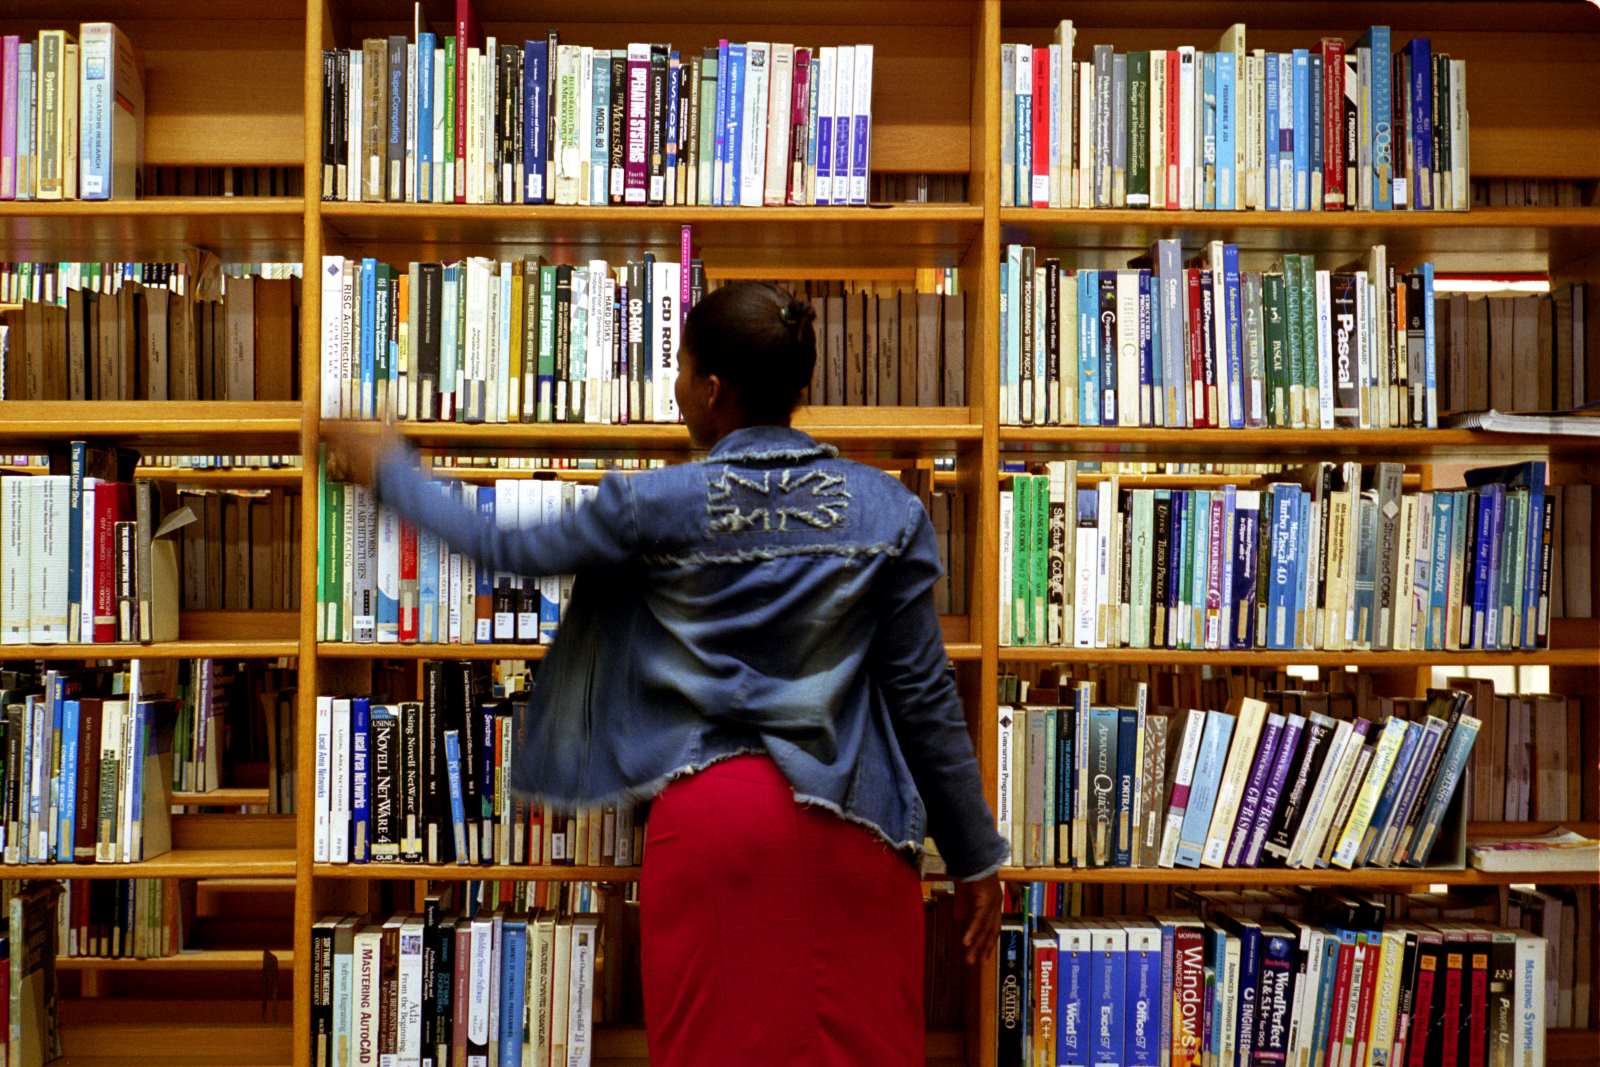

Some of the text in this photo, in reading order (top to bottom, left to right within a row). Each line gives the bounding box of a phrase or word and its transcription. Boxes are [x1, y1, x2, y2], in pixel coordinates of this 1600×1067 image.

[45, 71, 55, 109] Systems
[391, 70, 401, 143] SuperComputing
[654, 77, 662, 116] COMPUTER
[596, 108, 605, 147] MODEL 80
[613, 105, 623, 143] MODELS
[629, 68, 647, 163] OPERATING SYSTEMS
[1204, 136, 1215, 162] LISP
[629, 299, 642, 343] CD-ROM
[1289, 286, 1298, 325] DIGITAL
[1304, 287, 1314, 326] DIGITAL
[342, 314, 352, 378] Architecture
[662, 296, 671, 367] CD ROM
[1337, 314, 1354, 389] Pascal
[1273, 341, 1282, 370] PASCAL
[368, 512, 376, 558] NETWORKS
[1279, 499, 1290, 529] Turbo
[358, 511, 366, 579] ARCHITECTURES
[1157, 539, 1167, 566] TURBO
[1210, 506, 1221, 588] TEACH YOURSELF
[1278, 532, 1289, 563] Pascal
[1288, 522, 1298, 560] Mastering
[1382, 523, 1393, 574] Structured
[1436, 533, 1446, 560] TURBO
[1156, 567, 1166, 598] PROLOG
[1435, 562, 1445, 592] PASCAL
[377, 728, 390, 772] NOVELL
[483, 714, 492, 747] Sendmail
[1098, 723, 1108, 772] ADVANCED
[318, 734, 327, 798] Local Area Networks
[354, 733, 367, 808] Local Area Networks
[406, 709, 415, 811] Using Novell NetWare
[1000, 731, 1009, 821] Concurrent Programming
[377, 776, 390, 833] NETWARE
[1121, 775, 1130, 812] FORTRA
[322, 938, 331, 1006] SOFTWARE ENGINEERING
[361, 949, 372, 1008] MASTERING
[401, 998, 409, 1009] the
[409, 1002, 419, 1023] Ada
[1006, 975, 1016, 1029] QUATTRO
[1041, 960, 1052, 1039] Borland C++
[1066, 965, 1079, 1048] Running Word 97
[1136, 965, 1149, 1048] Running Office 97
[1182, 946, 1202, 1047] Windows
[1270, 971, 1289, 1047] WordPerfect
[1524, 960, 1535, 1049] MASTERING SYMPH
[399, 1012, 409, 1052] Beginning
[1100, 1006, 1110, 1037] Excel
[1101, 1037, 1109, 1048] 97
